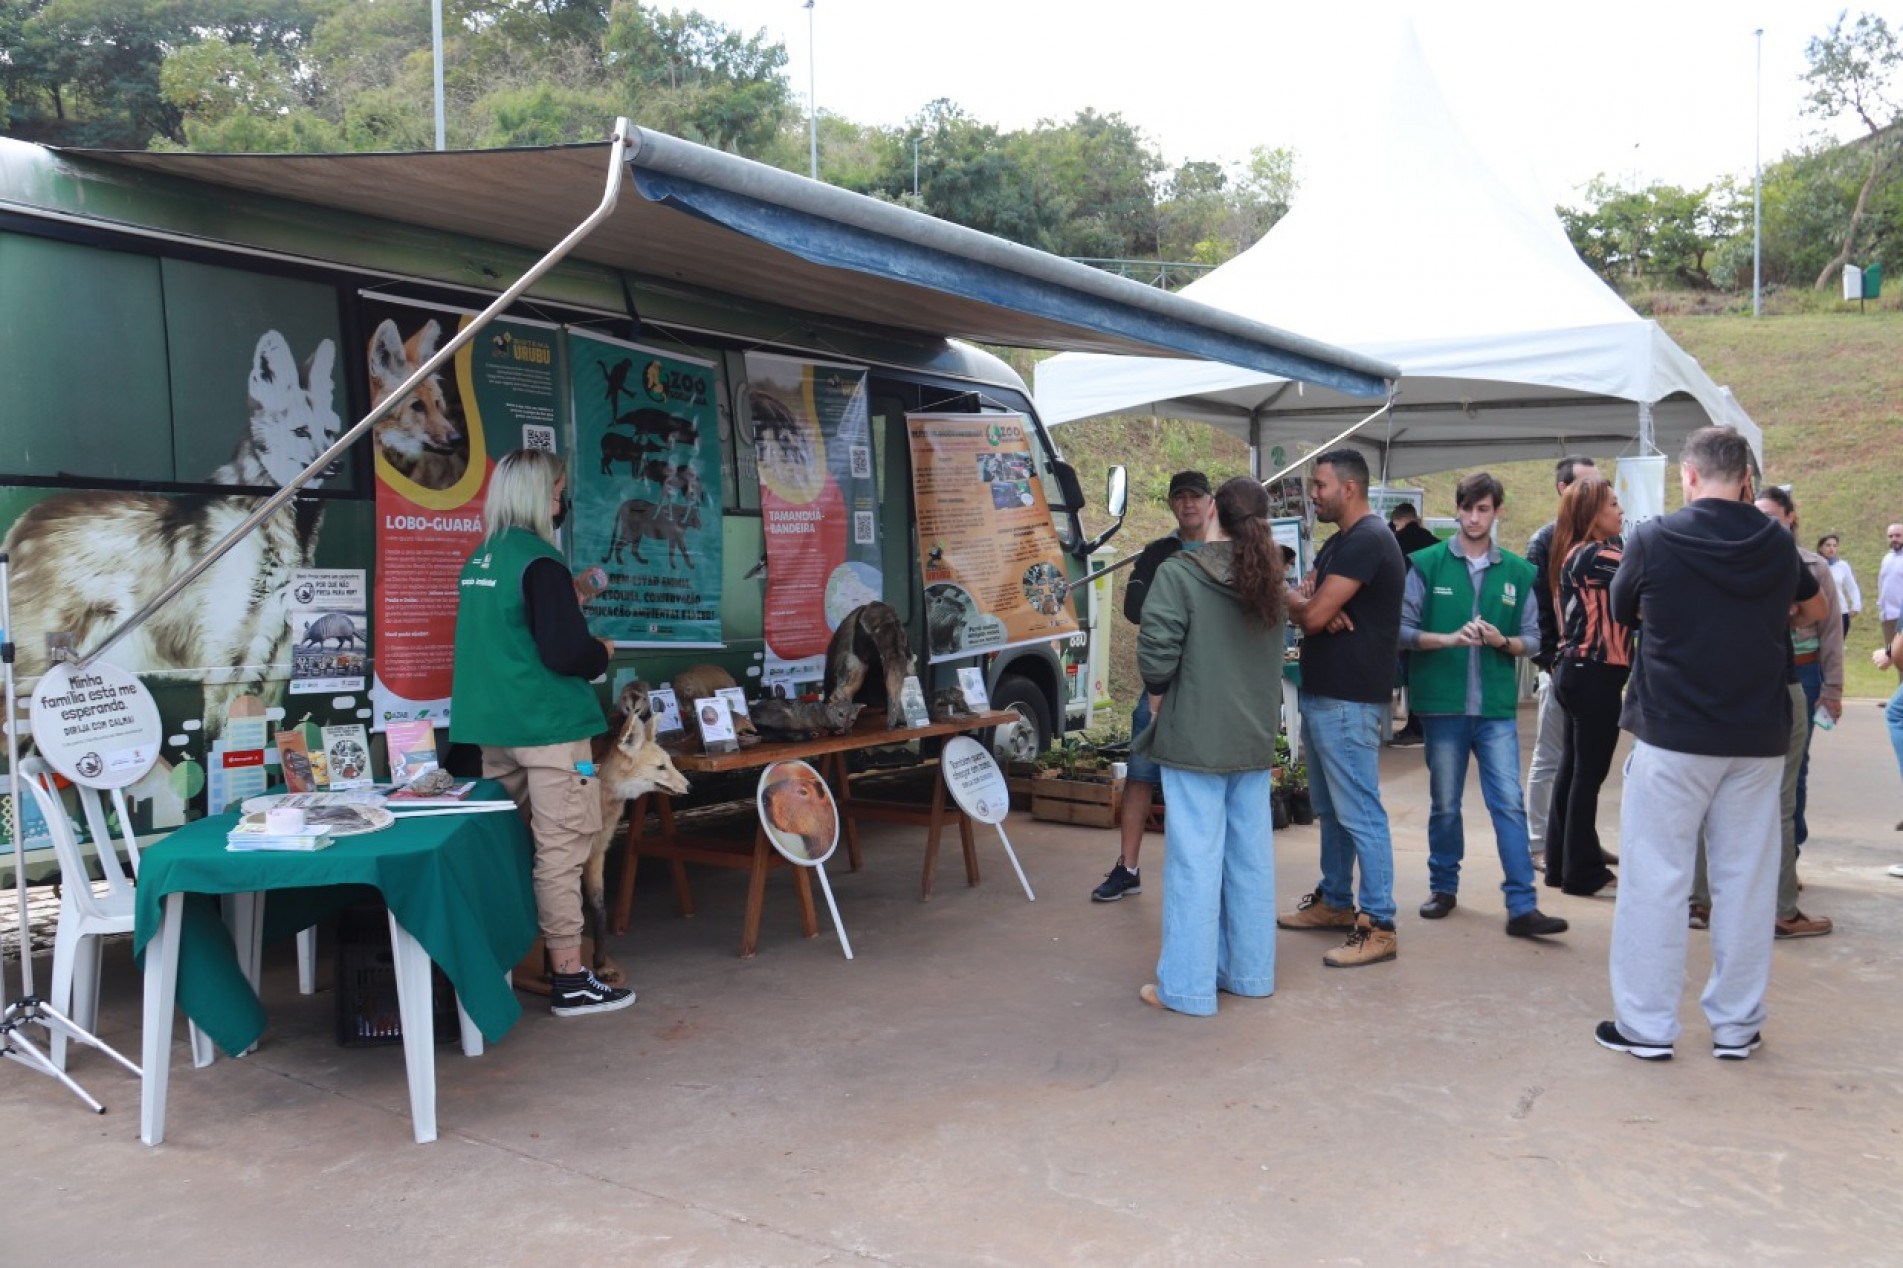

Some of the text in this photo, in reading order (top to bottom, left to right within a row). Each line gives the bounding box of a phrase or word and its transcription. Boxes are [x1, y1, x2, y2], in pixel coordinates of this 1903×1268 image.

[513, 345, 551, 365] URUBU
[670, 371, 706, 397] ZOO
[1001, 426, 1021, 437] ZOO
[385, 514, 483, 533] LOBO-GUARÁ
[769, 508, 825, 521] TAMANDUÁ-
[770, 523, 816, 535] BANDEIRA
[68, 673, 103, 690] Minha
[41, 683, 138, 709] família está me
[61, 698, 129, 721] esperando.
[63, 725, 90, 736] DIRIJA
[92, 721, 107, 731] COM
